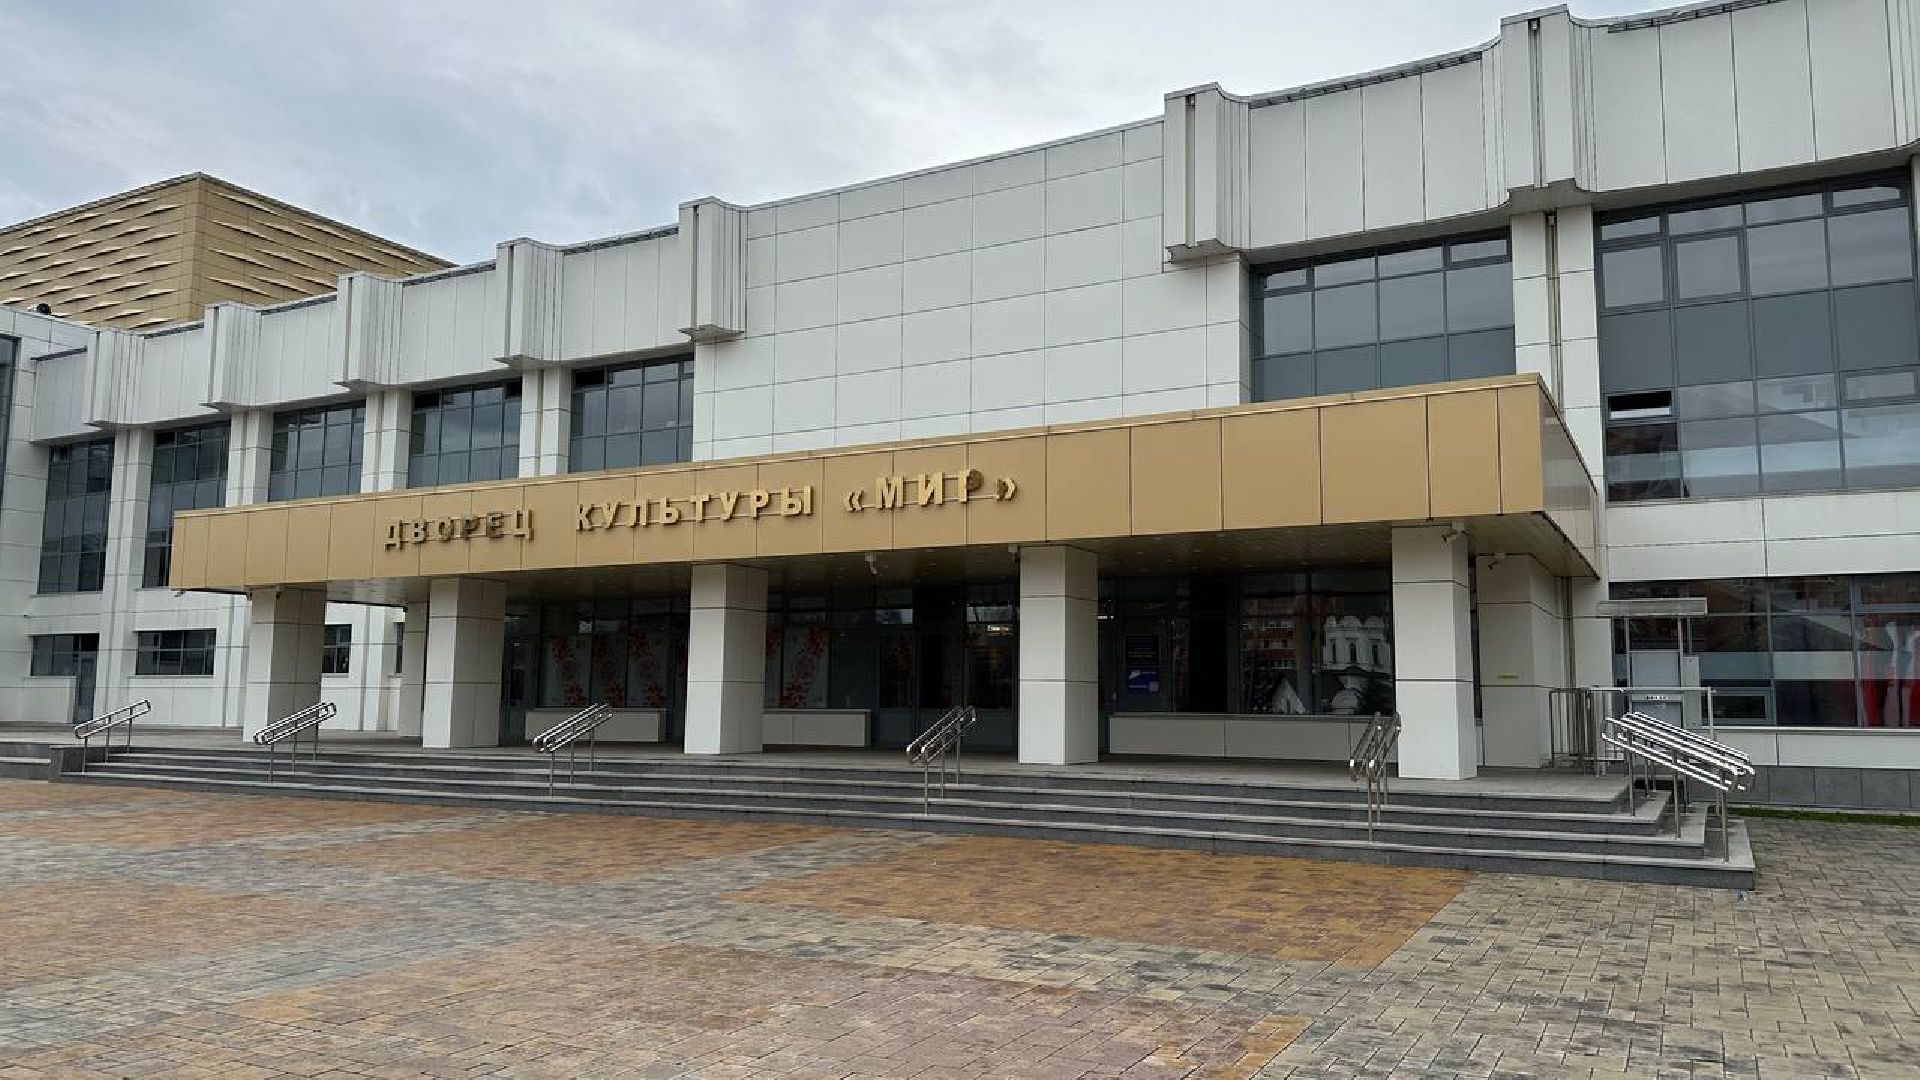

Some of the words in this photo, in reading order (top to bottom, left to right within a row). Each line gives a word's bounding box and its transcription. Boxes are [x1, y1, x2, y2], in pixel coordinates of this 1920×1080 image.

[384, 510, 535, 551] ДВОРЕЦ
[576, 485, 814, 532] КУЛЬТУРЫ
[845, 468, 1018, 513] «МИР»
